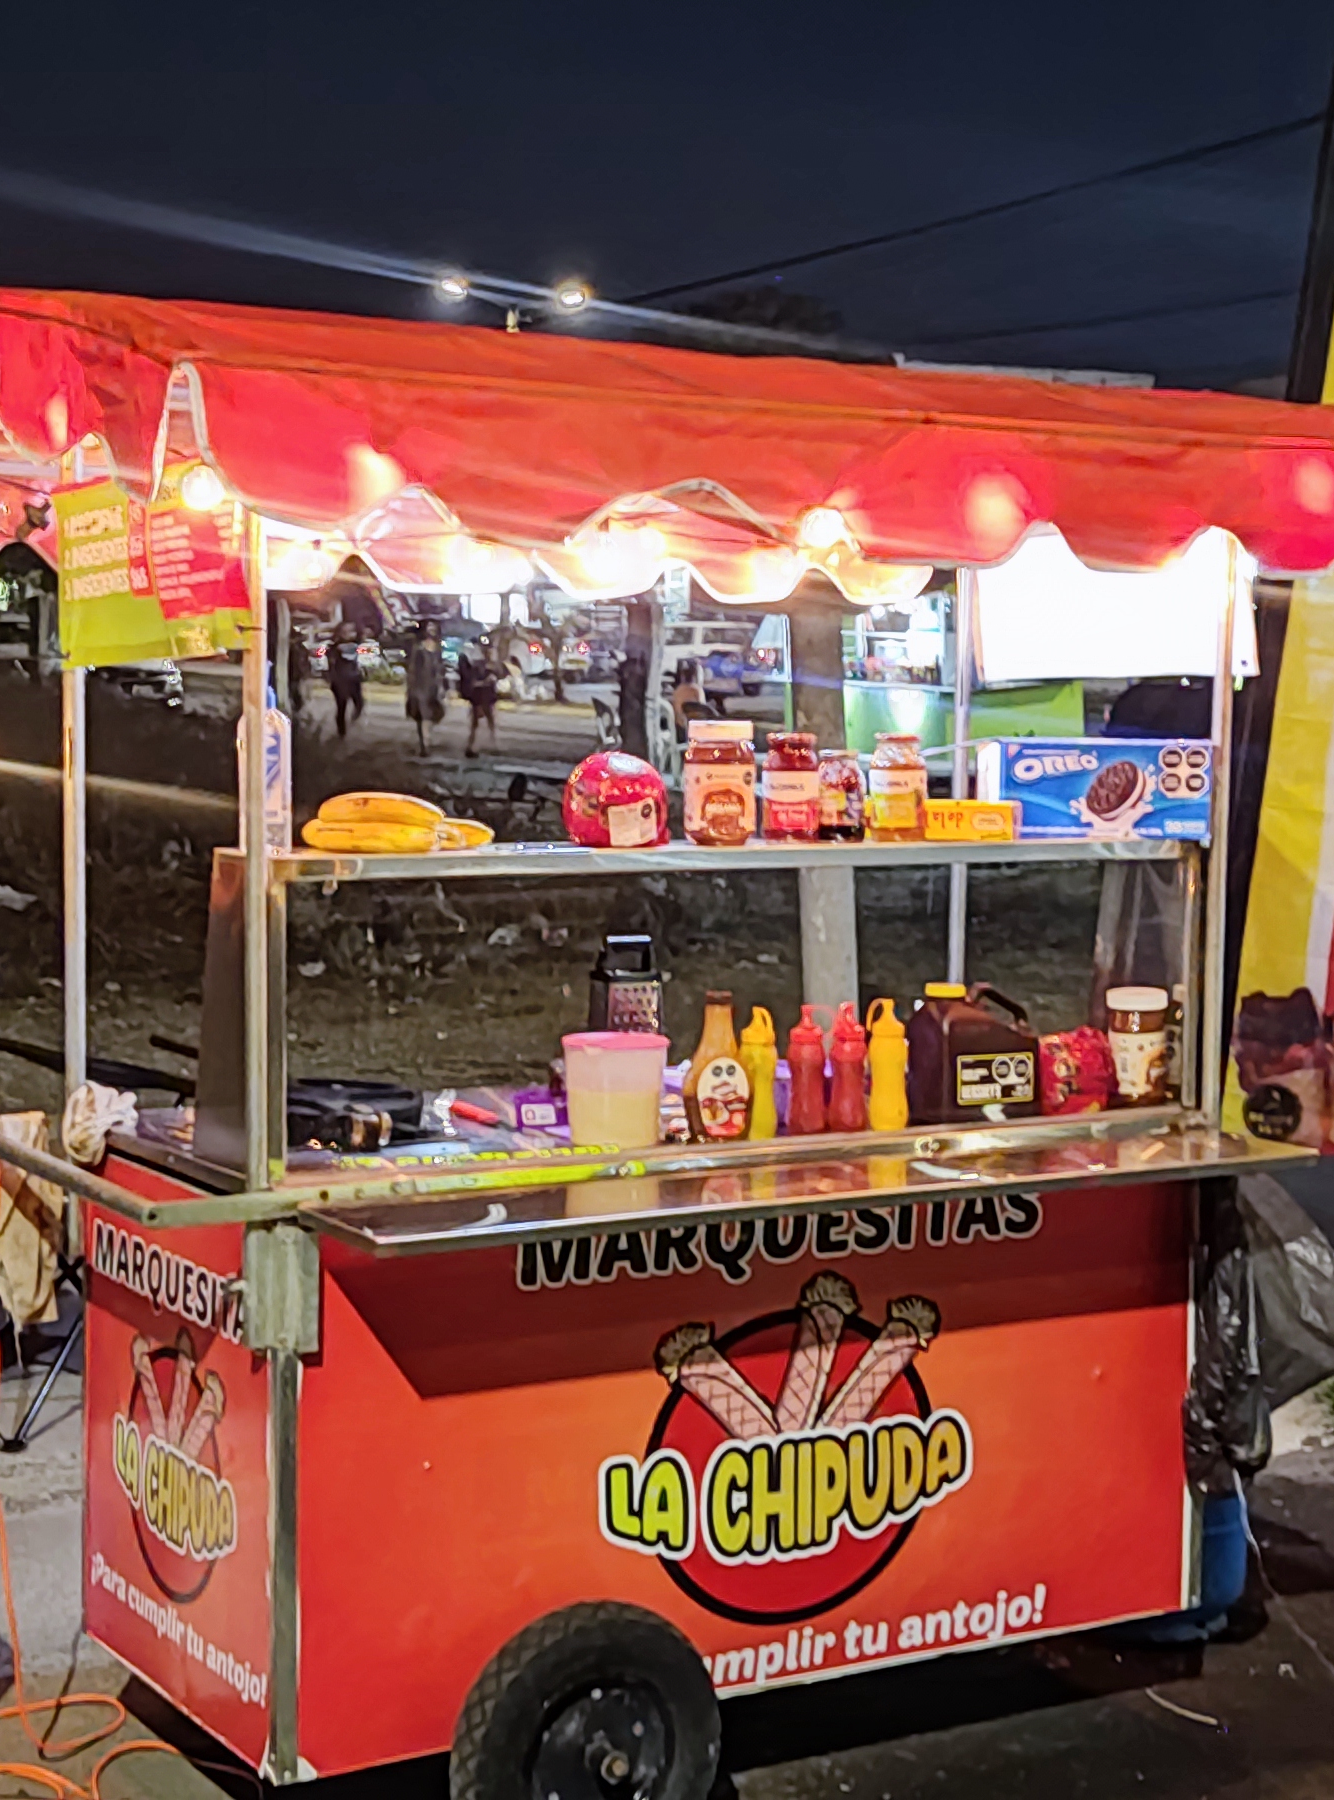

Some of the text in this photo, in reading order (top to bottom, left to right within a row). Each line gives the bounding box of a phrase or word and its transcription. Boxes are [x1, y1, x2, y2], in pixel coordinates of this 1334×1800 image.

[1013, 754, 1099, 784] OREO
[93, 1218, 244, 1344] MARQUESIT
[114, 1413, 237, 1558] LA CHIPUDA
[604, 1413, 968, 1559] LA CHIPUDA
[91, 1552, 267, 1709] ¡Para cumplir tu antojo!
[702, 1583, 1047, 1688] mplir tu antojo!
